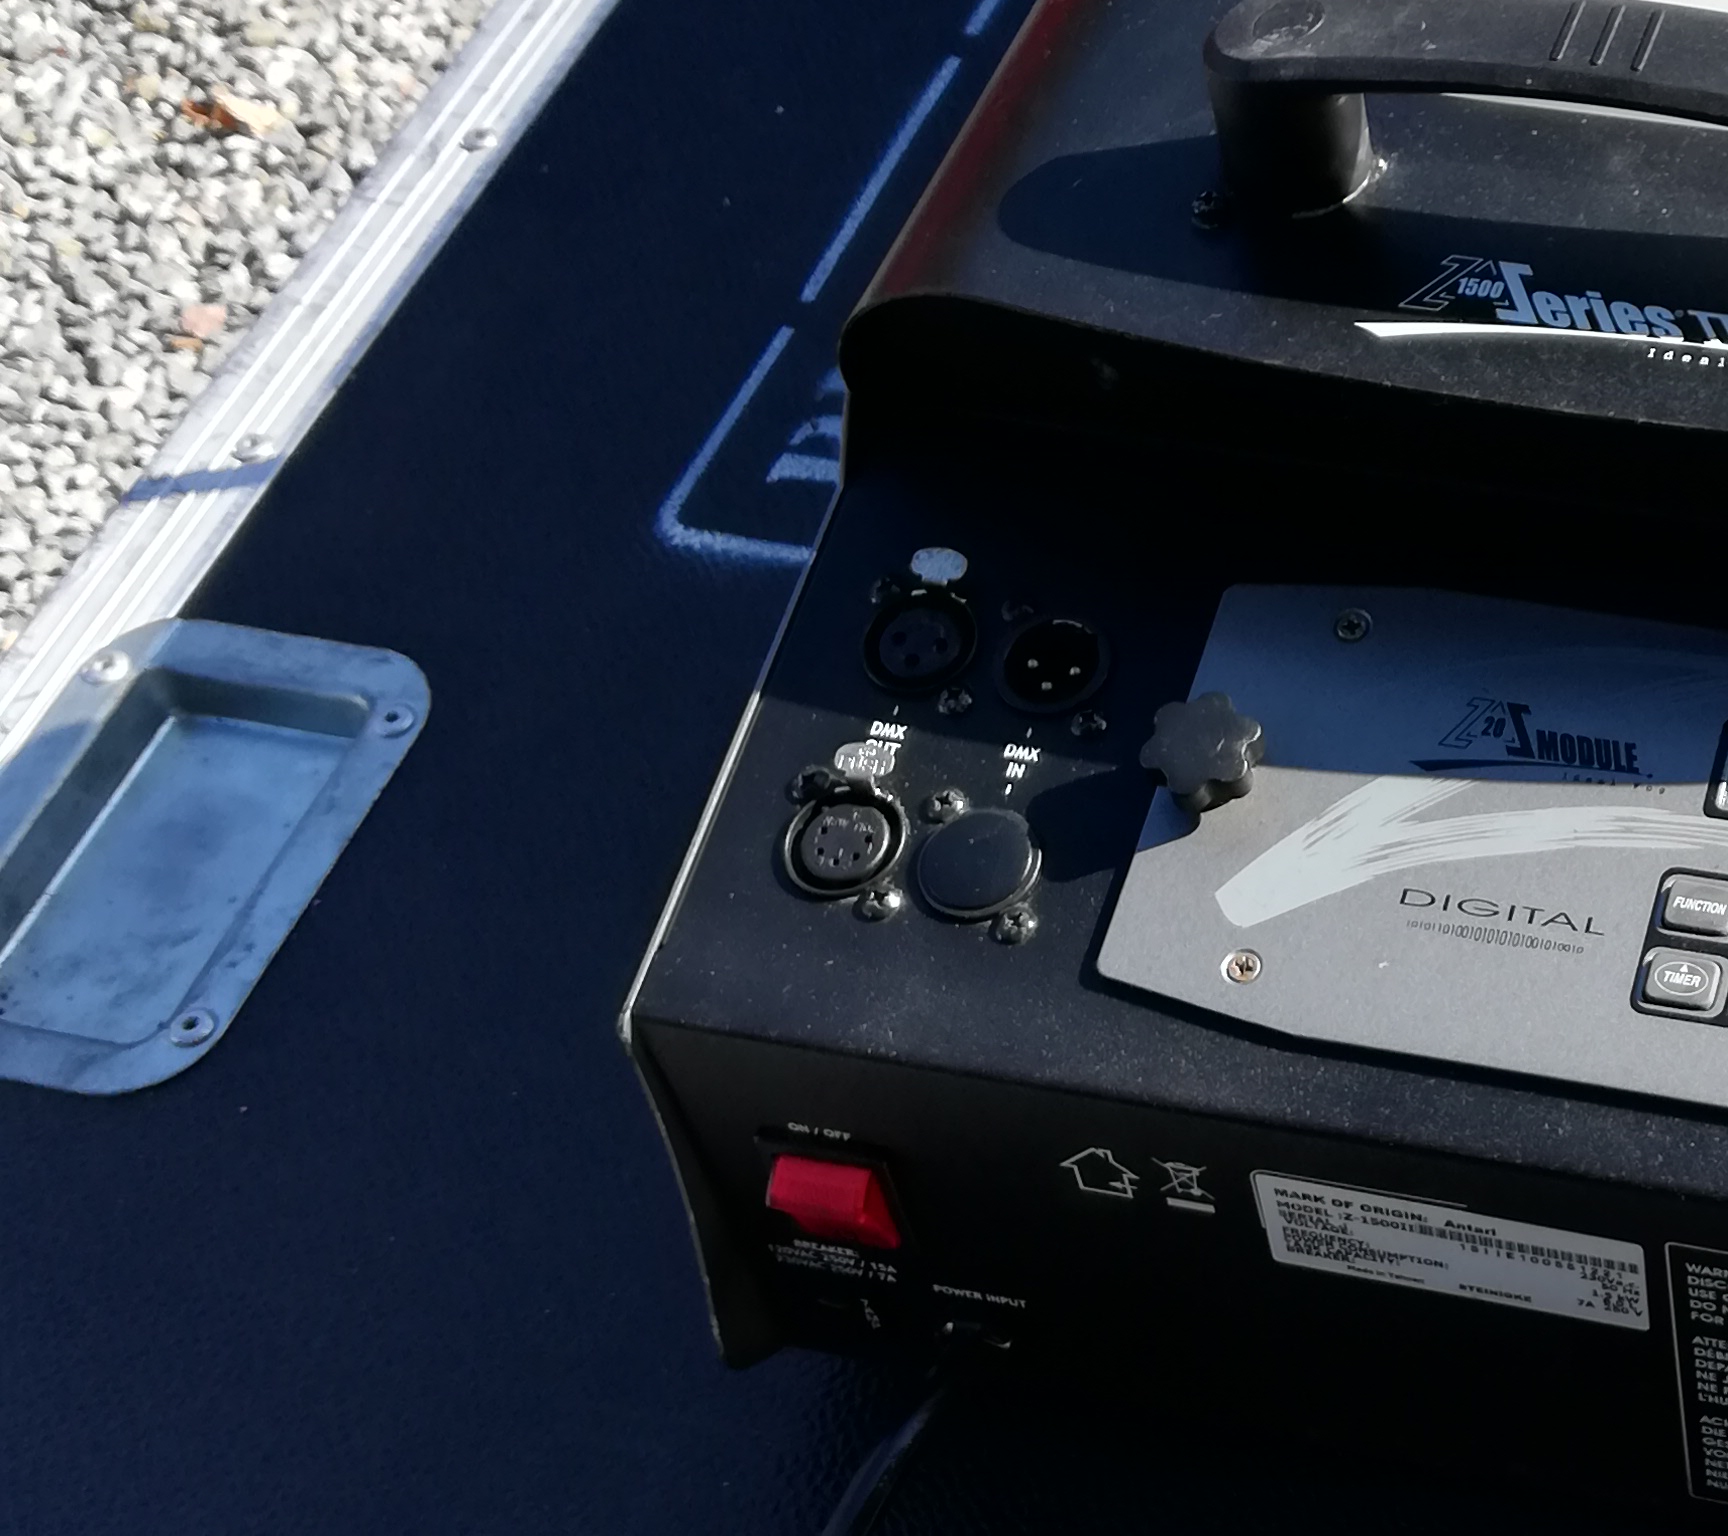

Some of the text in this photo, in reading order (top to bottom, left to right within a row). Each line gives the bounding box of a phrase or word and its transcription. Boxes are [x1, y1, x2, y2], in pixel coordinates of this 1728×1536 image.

[1457, 276, 1504, 300] 1500
[1496, 261, 1684, 339] Series
[1647, 347, 1726, 369] Ideal
[870, 720, 908, 740] DMX
[1481, 715, 1507, 739] 20
[1003, 743, 1041, 763] DMX
[1005, 761, 1027, 779] IN
[1399, 887, 1605, 937] DIGITAL
[1672, 895, 1728, 917] FUNCTION
[1663, 969, 1702, 989] TIMER
[1272, 1186, 1327, 1205] MARK
[1329, 1196, 1355, 1210] OF
[1442, 1218, 1497, 1237] Antari
[931, 1283, 1027, 1311] POWER INPUT
[1686, 1286, 1718, 1301] USE
[1688, 1310, 1725, 1326] FOR
[1699, 1425, 1727, 1439] DIE
